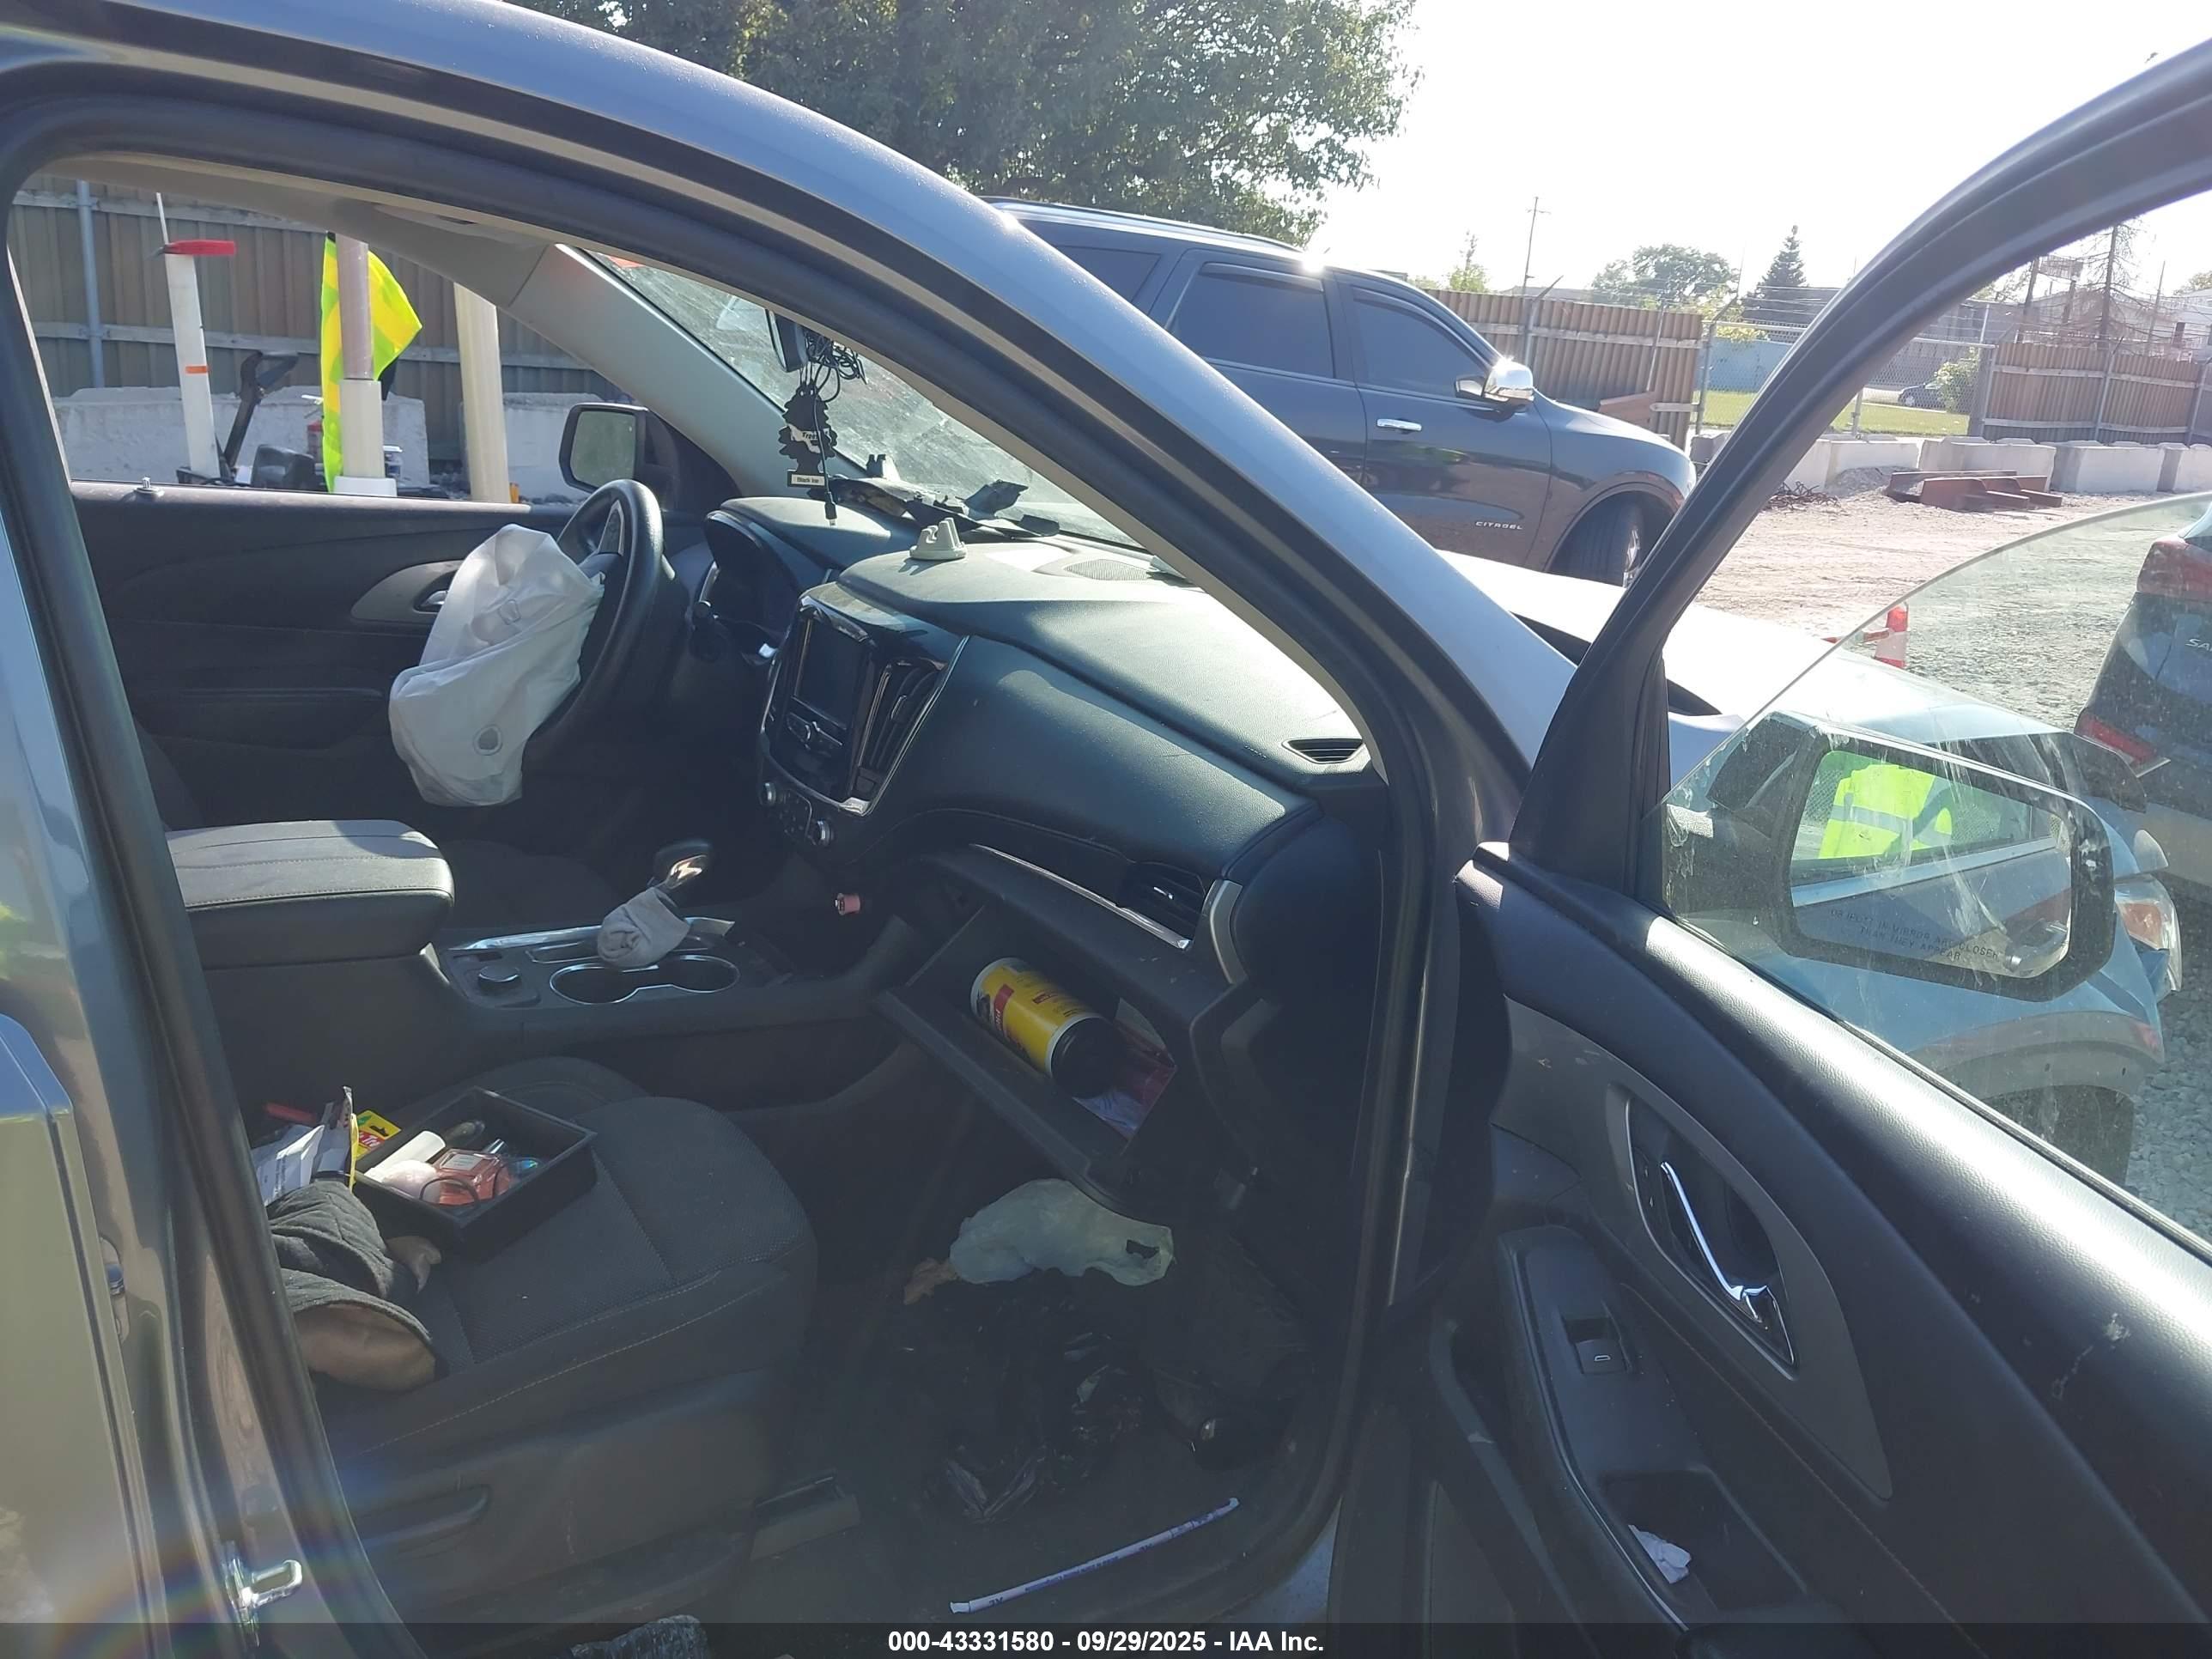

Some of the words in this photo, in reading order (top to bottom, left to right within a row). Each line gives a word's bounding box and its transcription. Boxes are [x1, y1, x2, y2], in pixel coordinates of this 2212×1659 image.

[1475, 520, 1523, 531] CITADEL
[2185, 638, 2212, 652] SA
[1890, 934, 1915, 949] THEY
[1919, 942, 1961, 961] APPEAR
